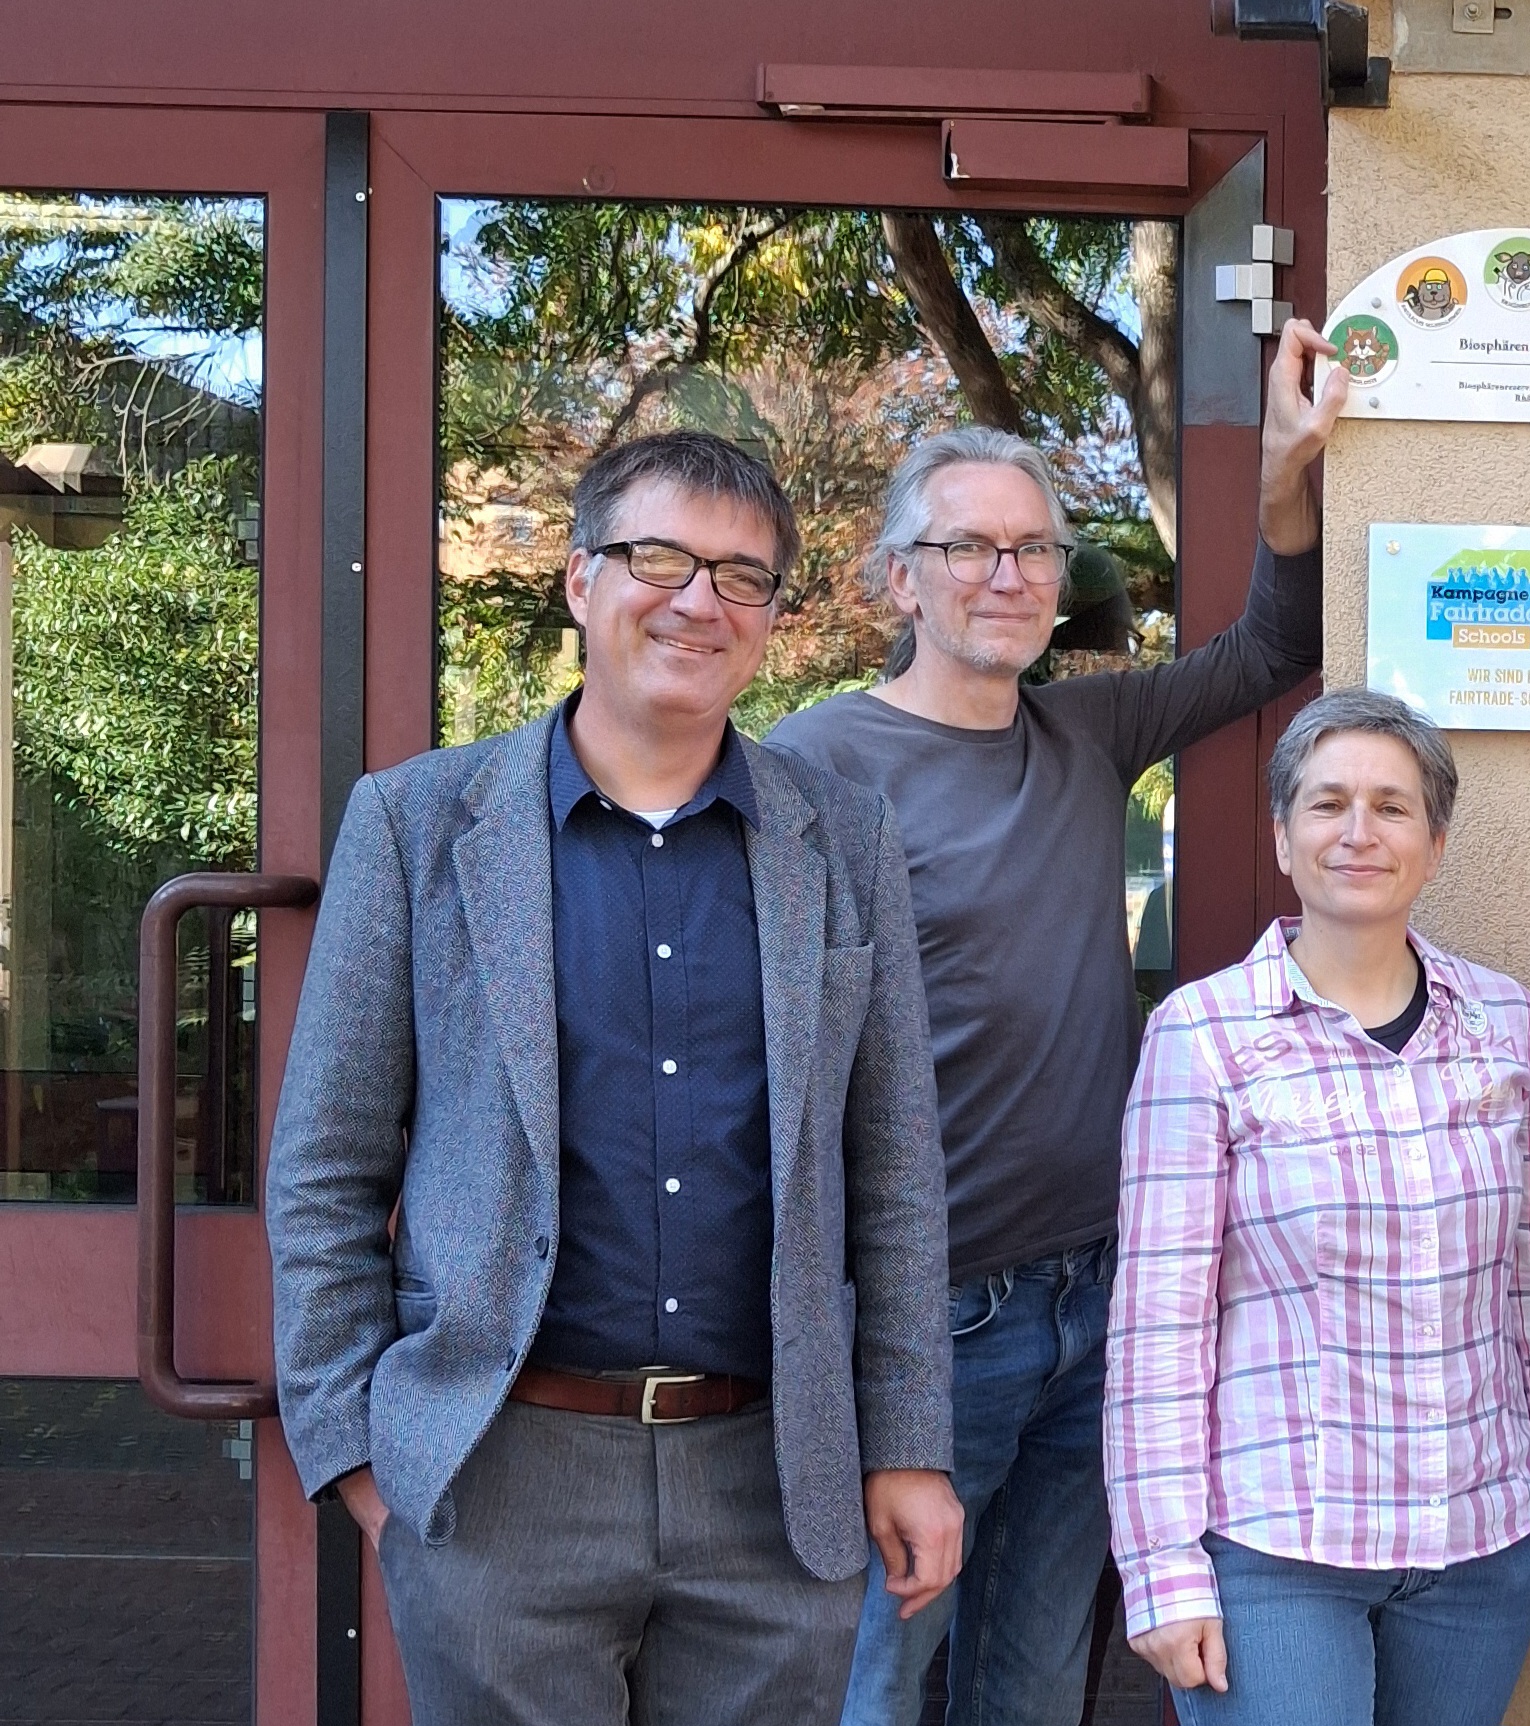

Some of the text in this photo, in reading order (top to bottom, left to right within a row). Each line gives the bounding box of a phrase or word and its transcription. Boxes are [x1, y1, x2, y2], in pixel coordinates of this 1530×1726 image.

[1430, 585, 1529, 604] Kampagne
[1457, 628, 1527, 645] Schools
[1467, 667, 1491, 684] WIR
[1494, 668, 1524, 684] SIND
